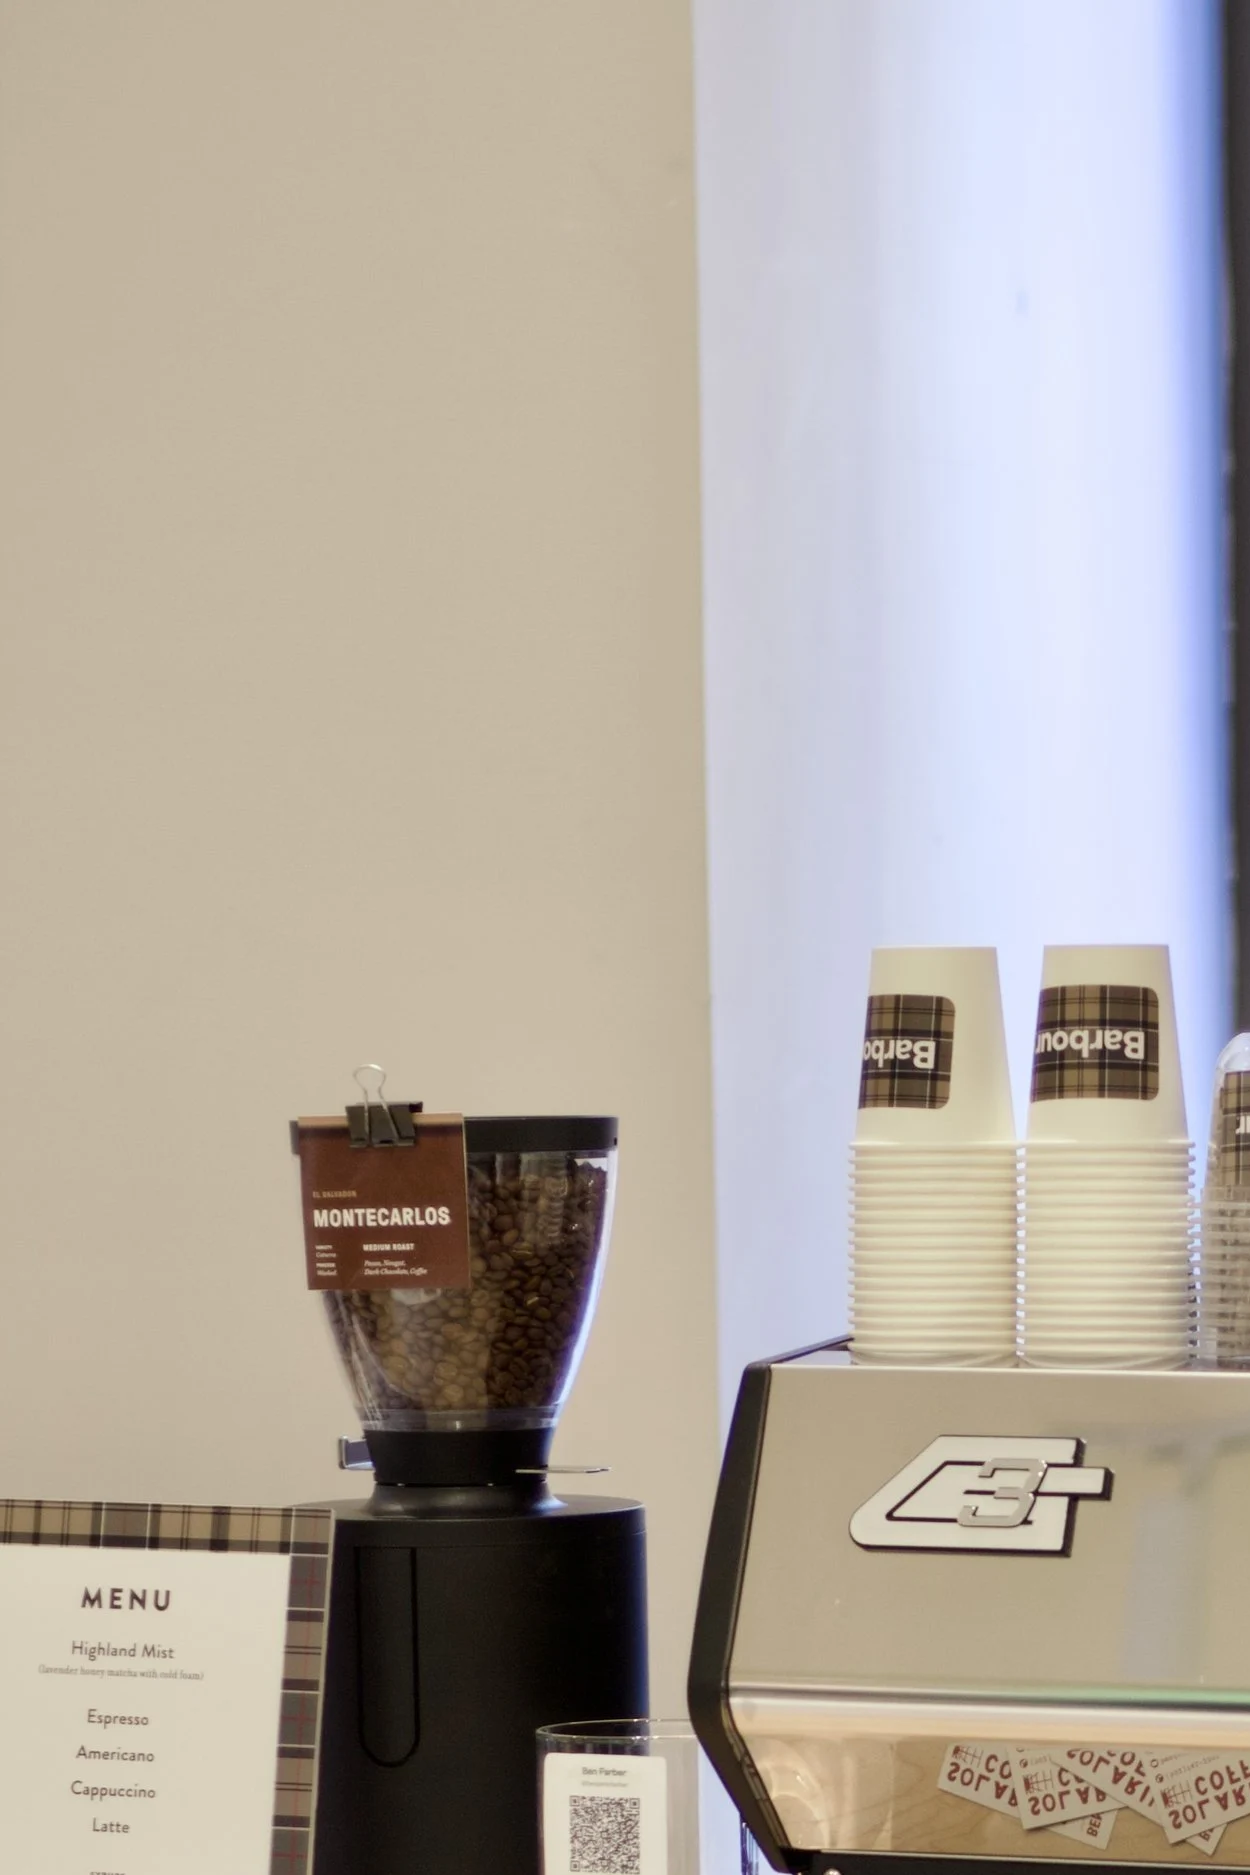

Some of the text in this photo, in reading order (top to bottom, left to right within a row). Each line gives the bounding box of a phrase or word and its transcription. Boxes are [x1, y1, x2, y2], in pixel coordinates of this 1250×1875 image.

[863, 1038, 936, 1069] Barbo
[1034, 1029, 1146, 1060] Barbour
[313, 1206, 451, 1228] MONTECARLOS
[363, 1243, 415, 1251] MEDIUM ROAST
[81, 1587, 172, 1612] MENU
[71, 1640, 175, 1661] Highland Mist
[140, 1668, 158, 1679] with
[87, 1708, 150, 1729] Espresso
[76, 1744, 155, 1762] Americano
[70, 1780, 156, 1802] Cappuccino
[92, 1817, 130, 1833] Latte
